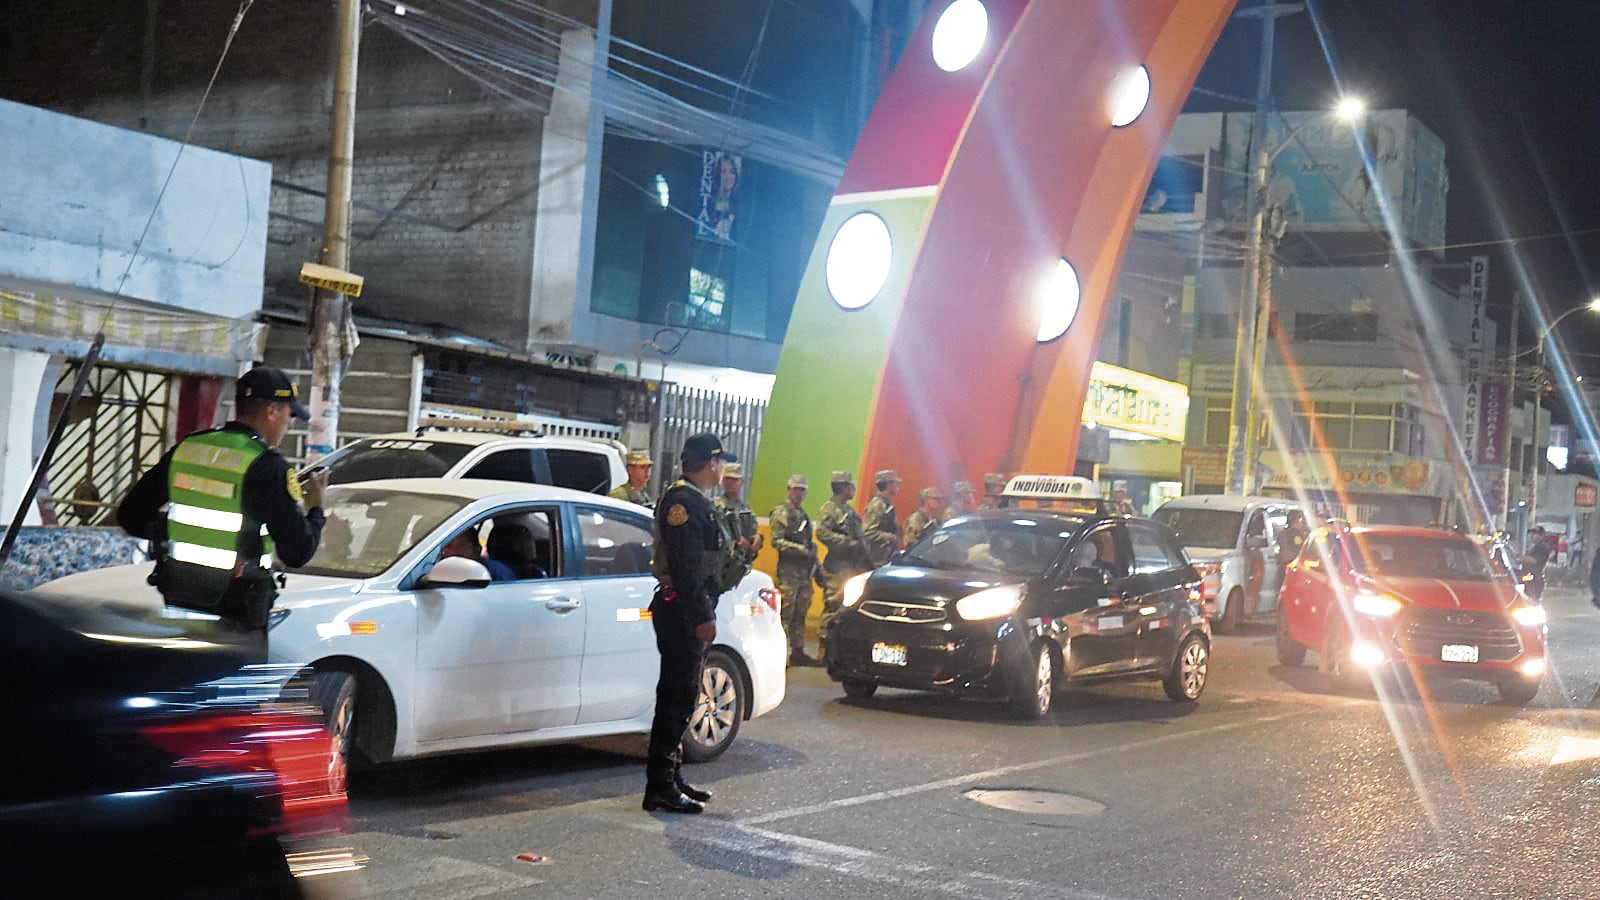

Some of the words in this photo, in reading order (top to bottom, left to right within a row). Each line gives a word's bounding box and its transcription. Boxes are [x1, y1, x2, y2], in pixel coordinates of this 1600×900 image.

[698, 151, 715, 236] DENTAL
[1471, 262, 1484, 343] DENTAL
[370, 440, 434, 451] USE
[1464, 358, 1479, 460] BRACKETS
[1012, 480, 1070, 494] INDIVIDUAL
